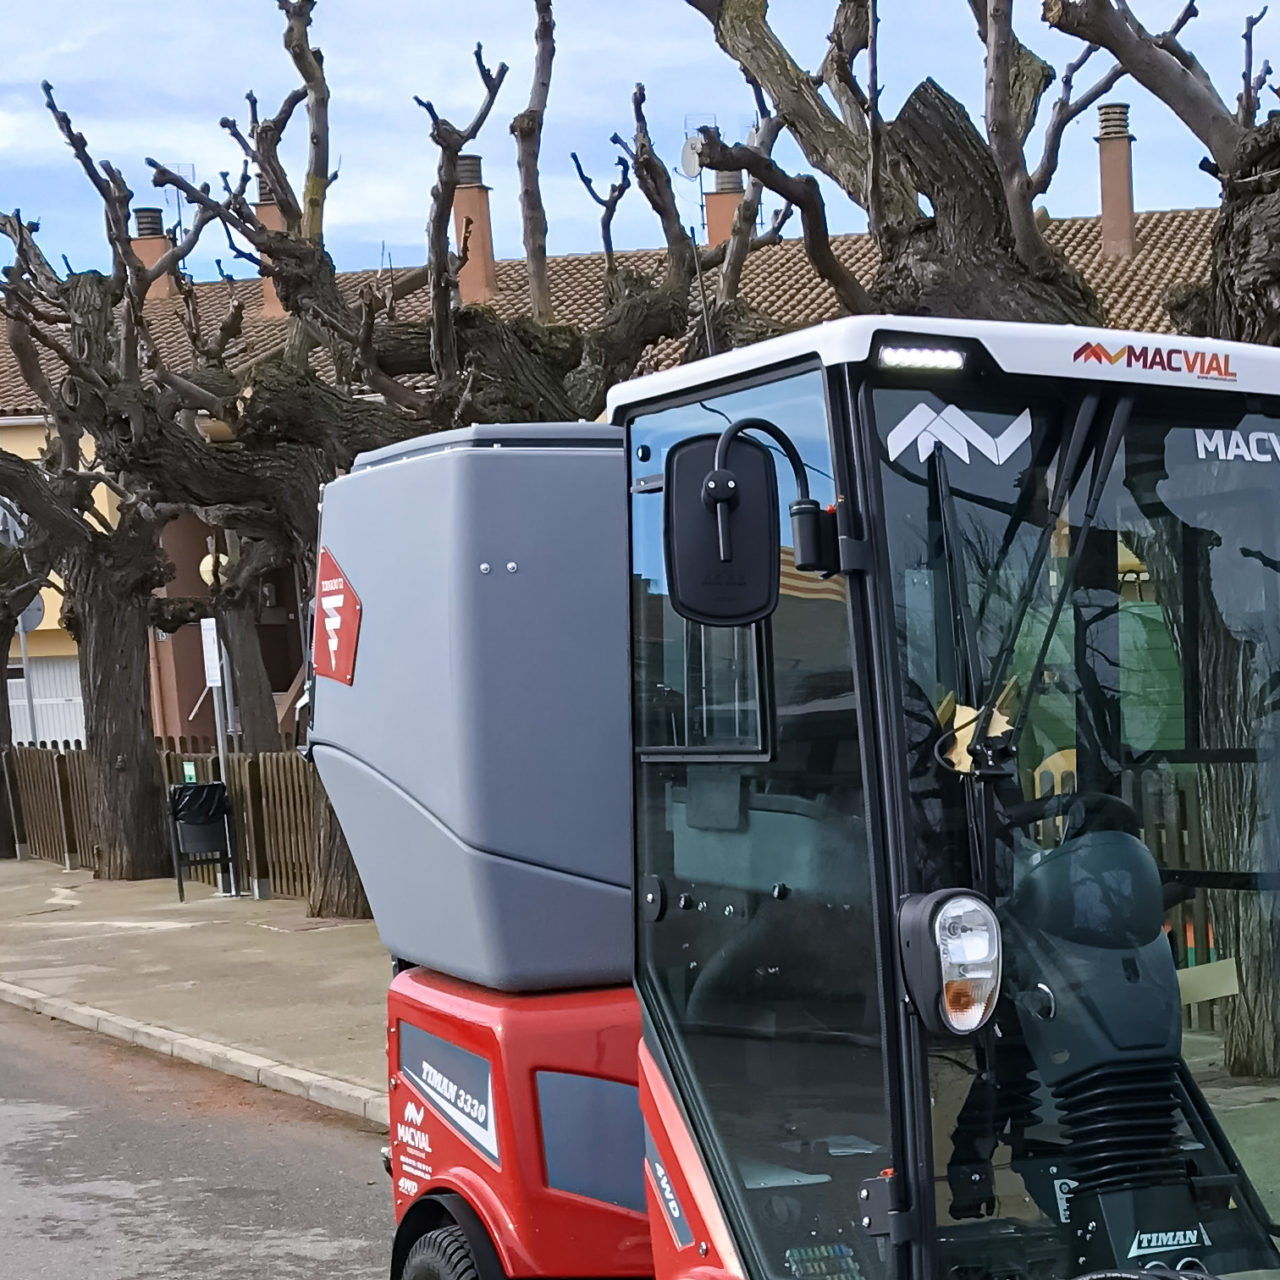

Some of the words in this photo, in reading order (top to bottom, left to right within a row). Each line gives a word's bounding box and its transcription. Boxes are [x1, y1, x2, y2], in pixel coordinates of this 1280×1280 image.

[1126, 345, 1237, 377] MACVIAL
[421, 1060, 458, 1104] TIMAN
[456, 1089, 487, 1124] 3330
[397, 1122, 432, 1153] MACVIAL
[655, 1162, 680, 1218] 4WD
[1139, 1229, 1198, 1248] TIMAN
